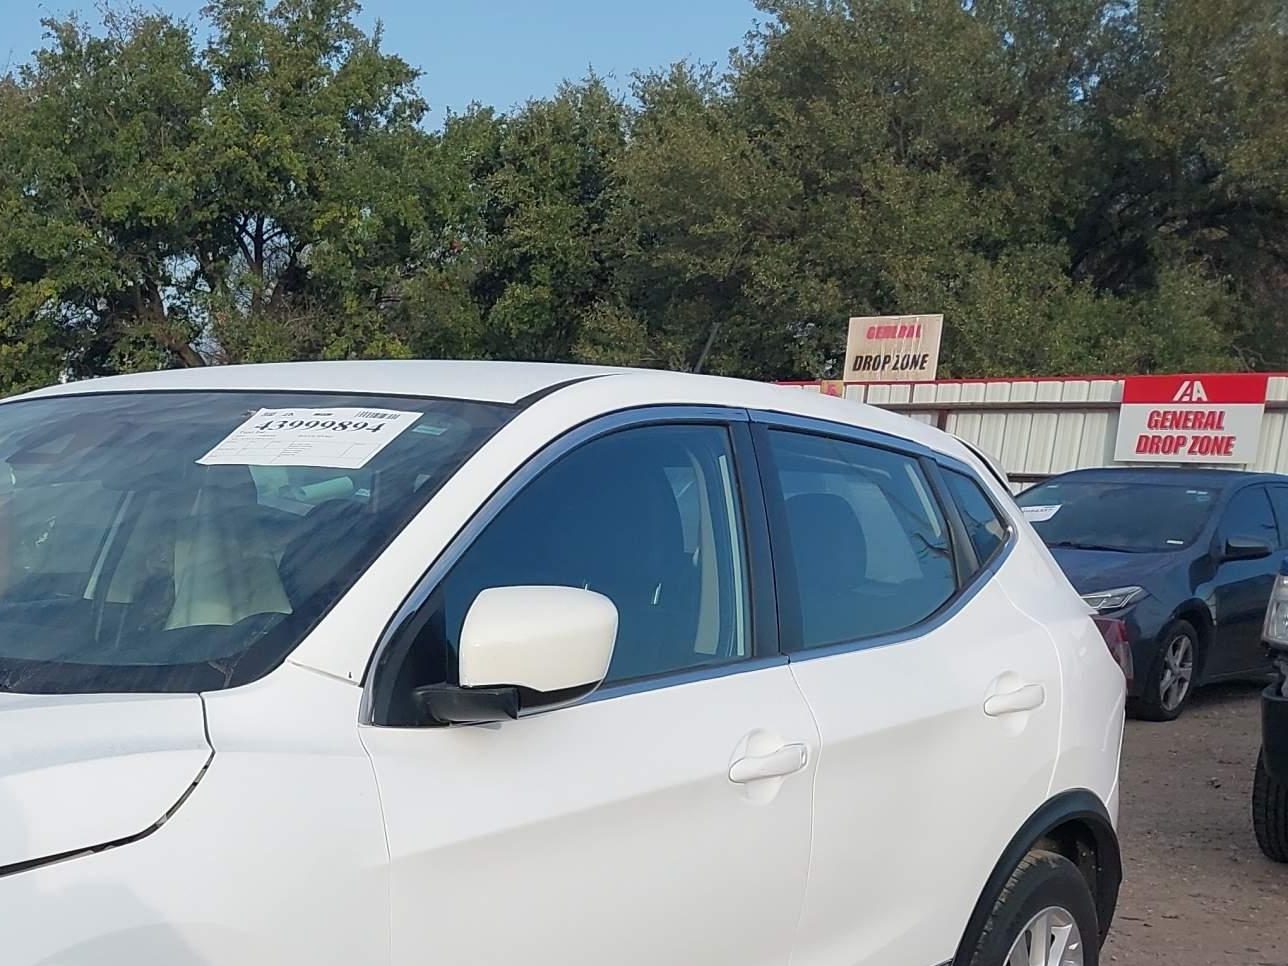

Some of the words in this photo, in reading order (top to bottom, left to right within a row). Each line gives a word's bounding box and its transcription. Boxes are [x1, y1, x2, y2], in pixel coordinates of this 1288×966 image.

[852, 354, 891, 372] DROP
[892, 353, 929, 371] ZONE
[254, 419, 387, 433] 43999894
[1147, 410, 1225, 431] GENERAL
[1136, 434, 1187, 455] DROP
[1187, 435, 1236, 456] ZONE
